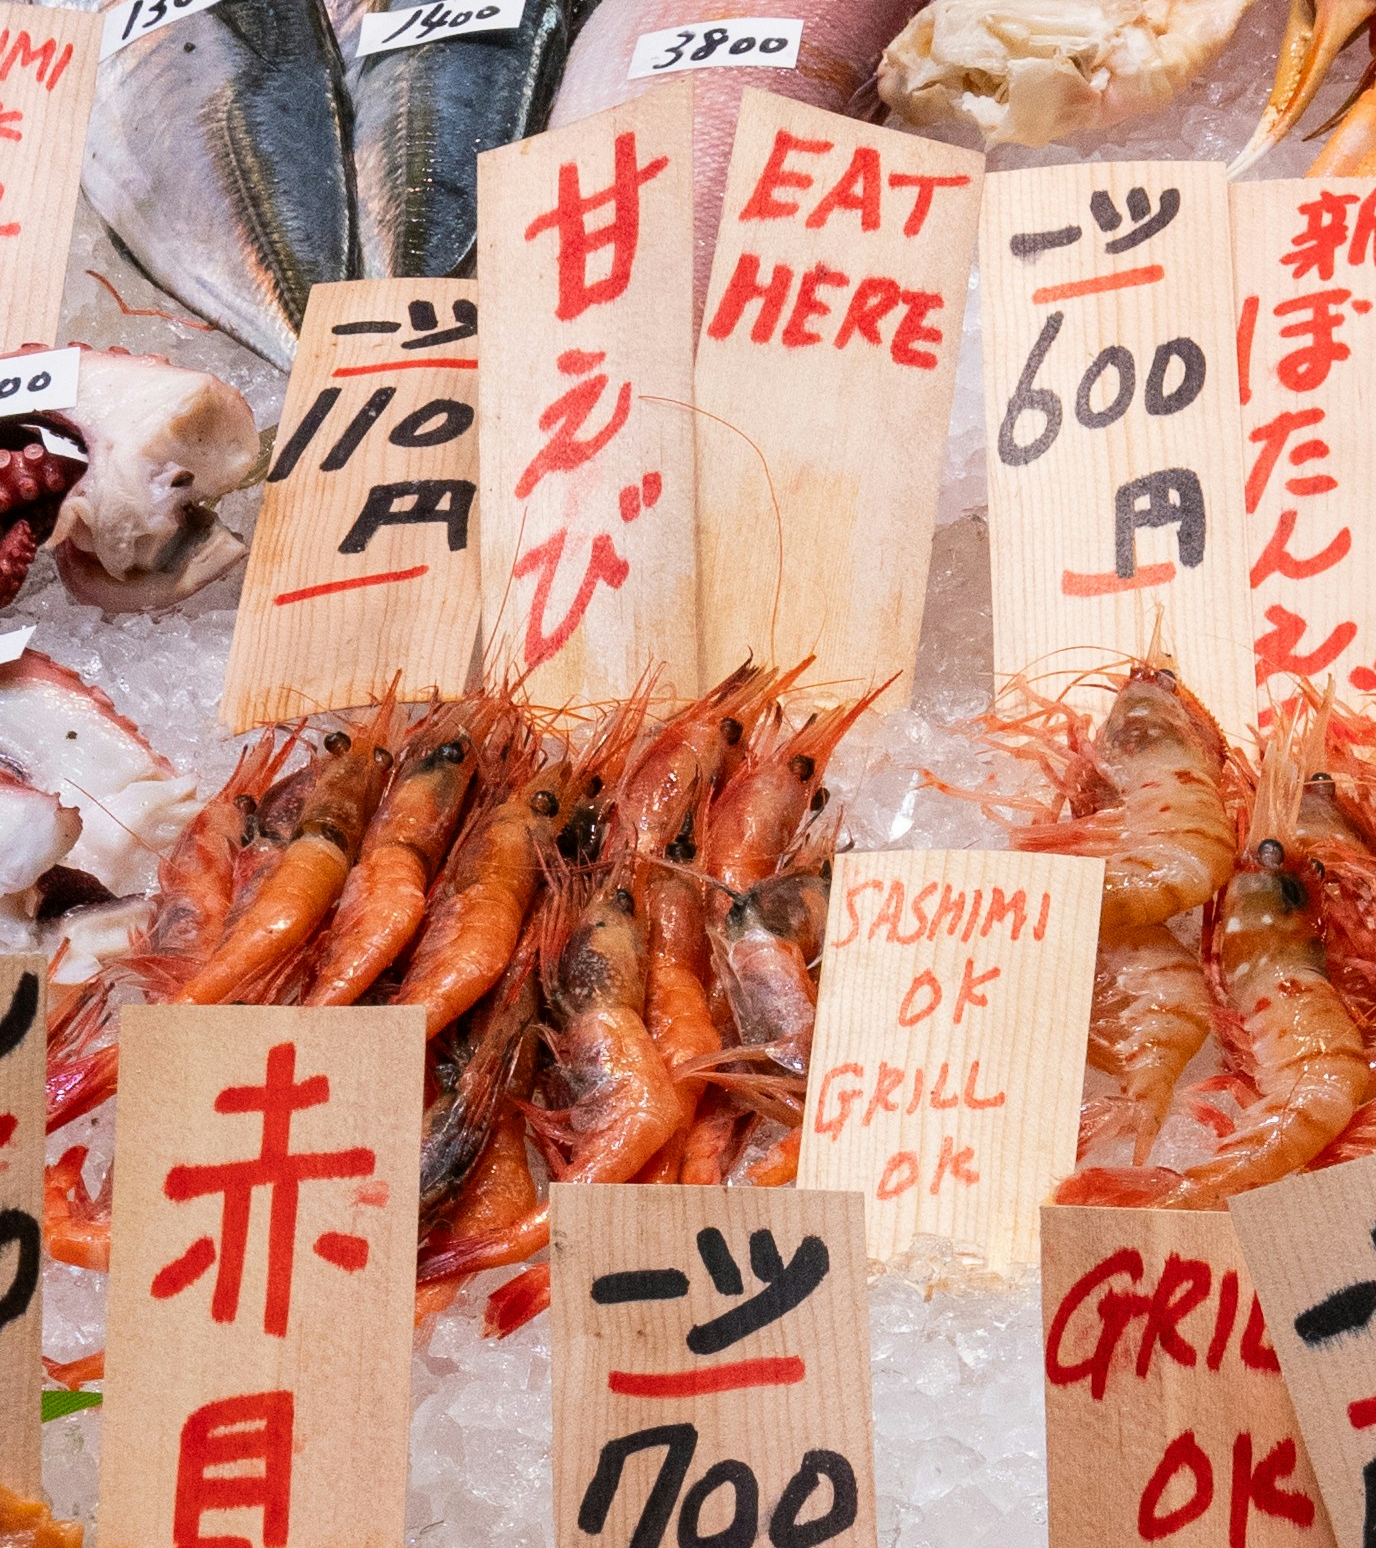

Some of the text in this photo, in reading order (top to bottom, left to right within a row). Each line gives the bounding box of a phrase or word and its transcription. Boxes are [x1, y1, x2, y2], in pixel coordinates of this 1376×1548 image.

[381, 3, 502, 44] 1400
[651, 29, 789, 70] 3800
[739, 129, 971, 237] EAT
[1009, 186, 1181, 262] 一ツ
[332, 300, 477, 349] 一ツ
[707, 253, 944, 370] HERE
[514, 130, 670, 668] 甘えび
[997, 310, 1208, 468] 600
[266, 387, 473, 482] 110
[338, 480, 476, 553] 円
[1114, 467, 1207, 579] 円
[832, 878, 1049, 951] SASHIMI
[900, 959, 1000, 1026] OK
[815, 1061, 1005, 1140] GRILL
[878, 1144, 978, 1199] OK
[590, 1227, 829, 1355] 一ツ
[1045, 1248, 1281, 1400] GRIL
